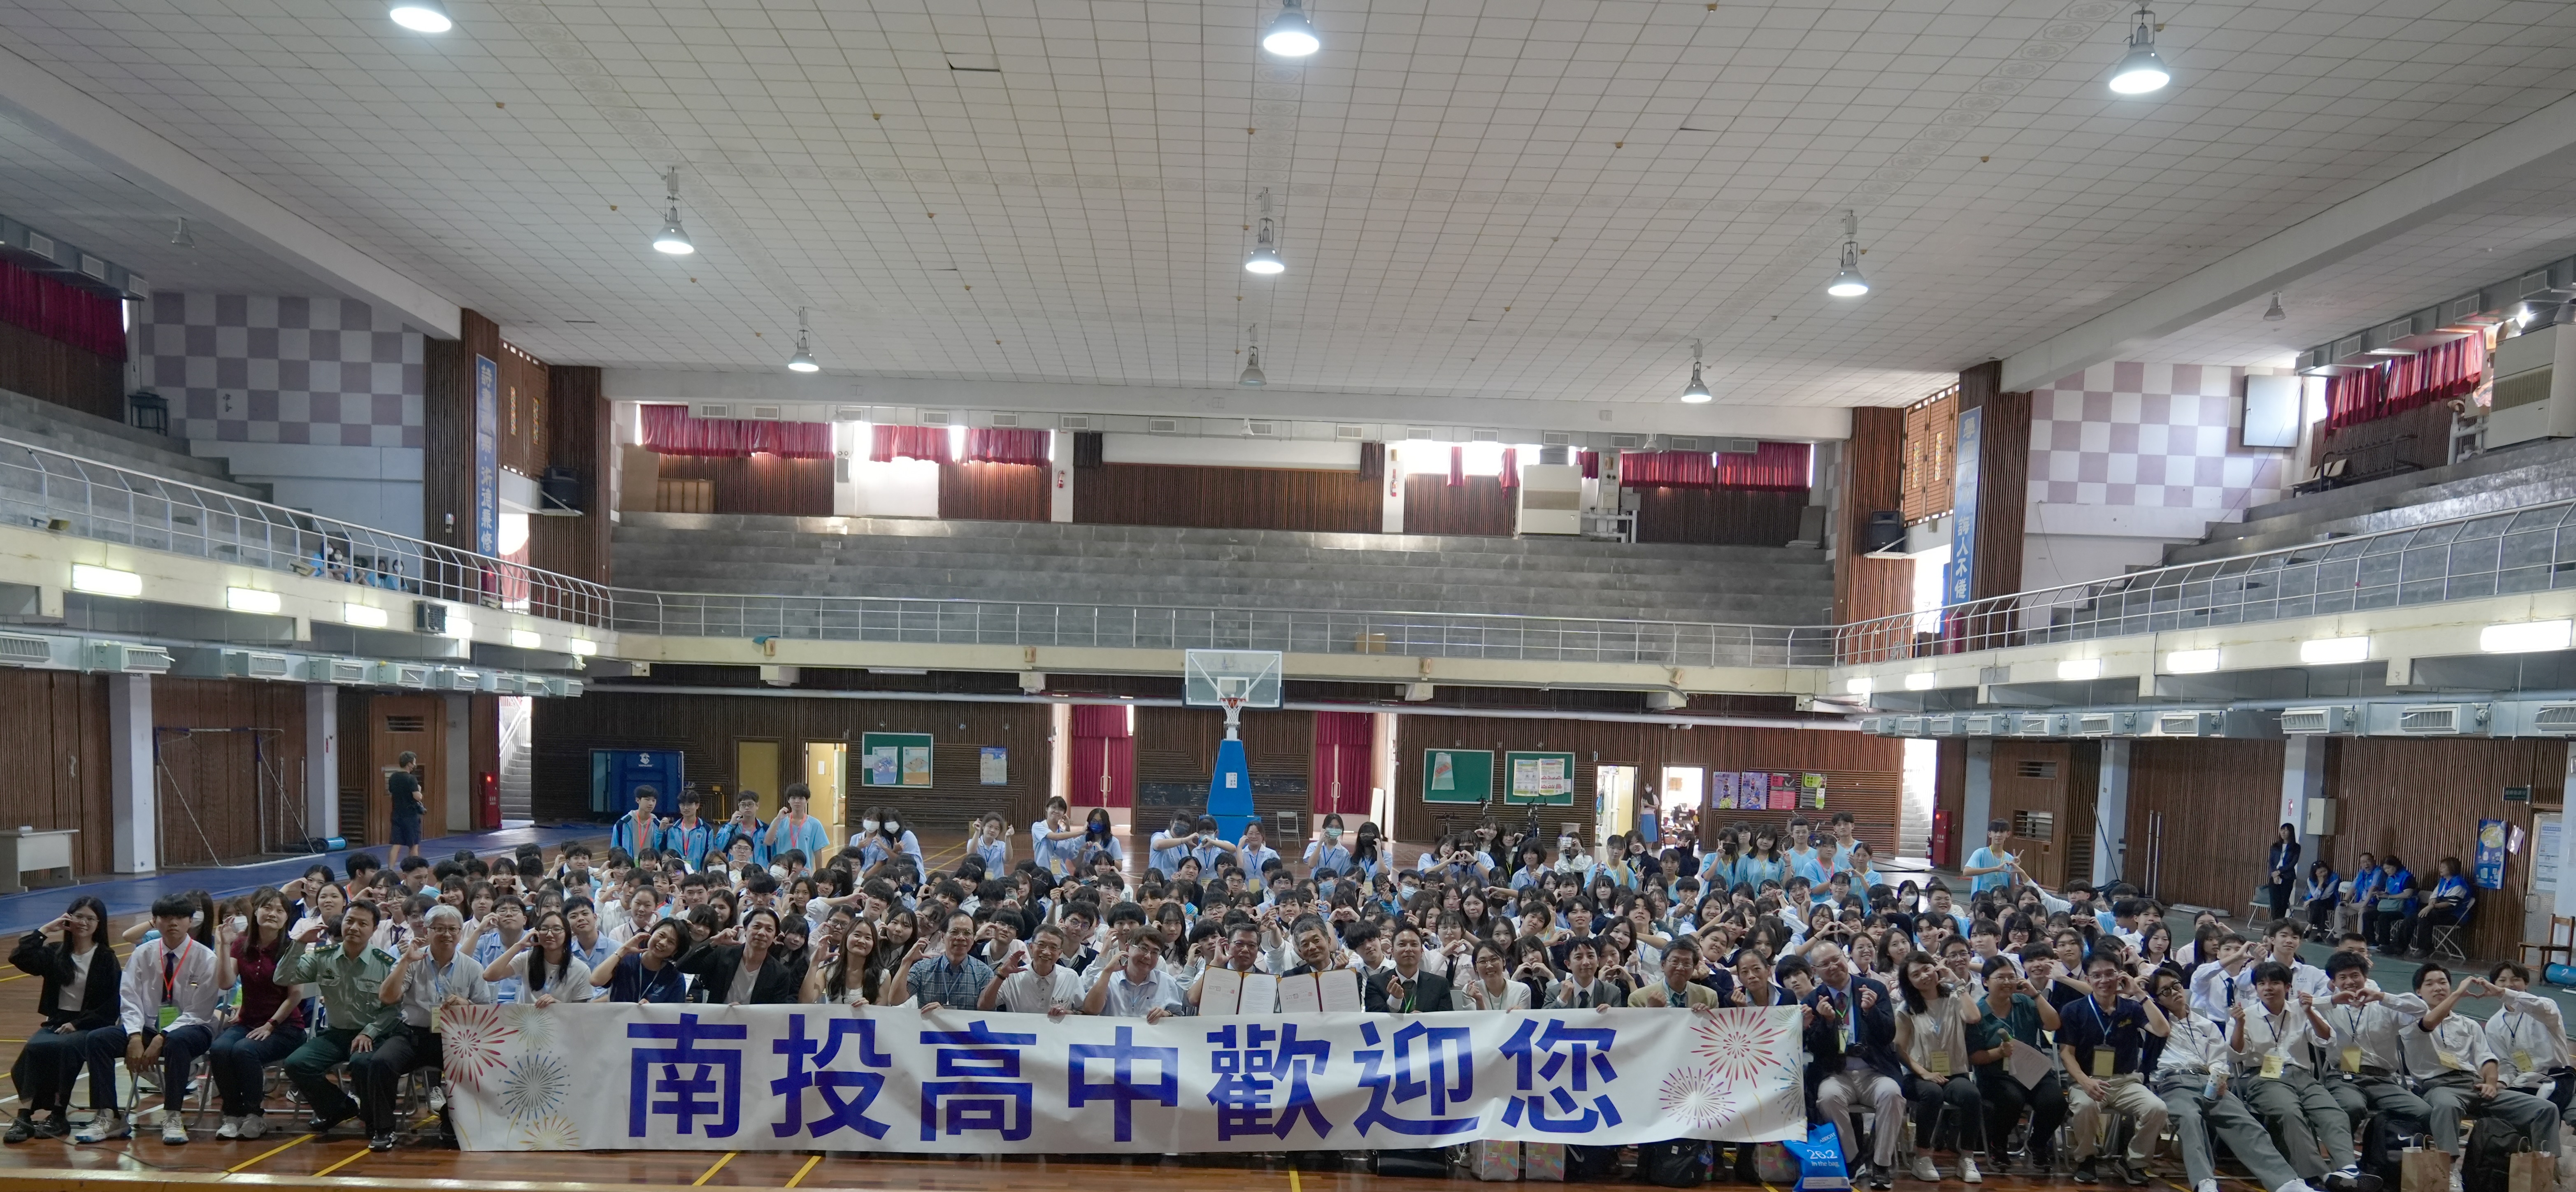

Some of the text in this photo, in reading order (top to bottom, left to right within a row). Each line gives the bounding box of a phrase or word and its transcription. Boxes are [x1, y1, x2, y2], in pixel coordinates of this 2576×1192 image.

[628, 1013, 1623, 1143] 南投高中歡迎您
[1806, 1149, 1838, 1159] 26.2
